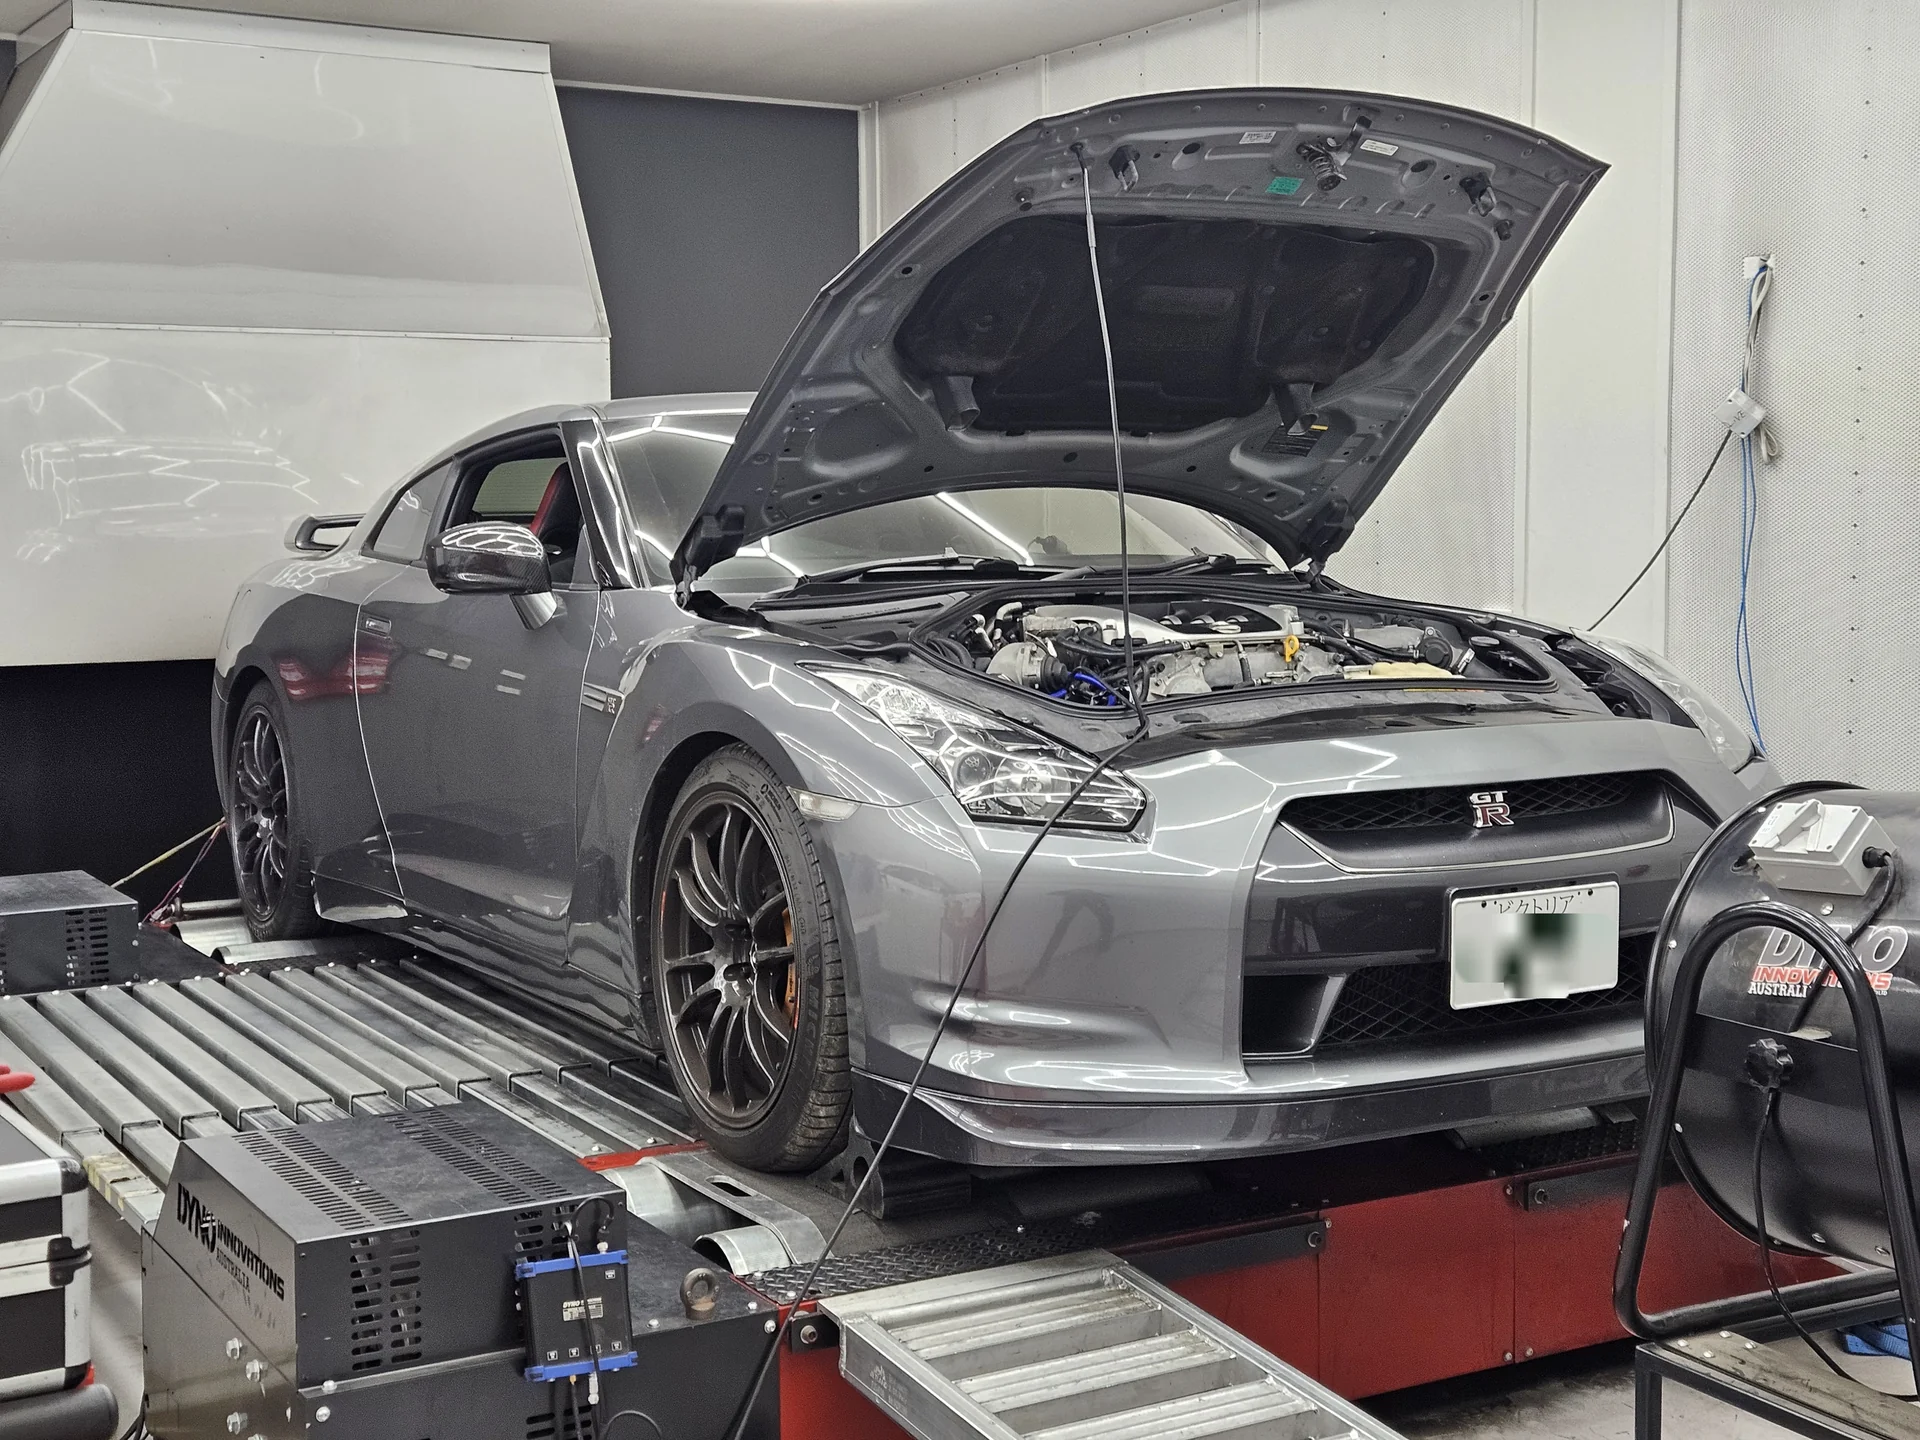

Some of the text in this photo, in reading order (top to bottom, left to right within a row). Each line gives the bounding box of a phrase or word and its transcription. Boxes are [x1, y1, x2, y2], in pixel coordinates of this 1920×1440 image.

[1469, 790, 1508, 804] GT
[1472, 802, 1515, 828] R
[1747, 982, 1812, 998] AUSTRALI
[177, 1182, 284, 1301] DYNO INNOVATIONS
[216, 1247, 250, 1293] AUSTRALIA
